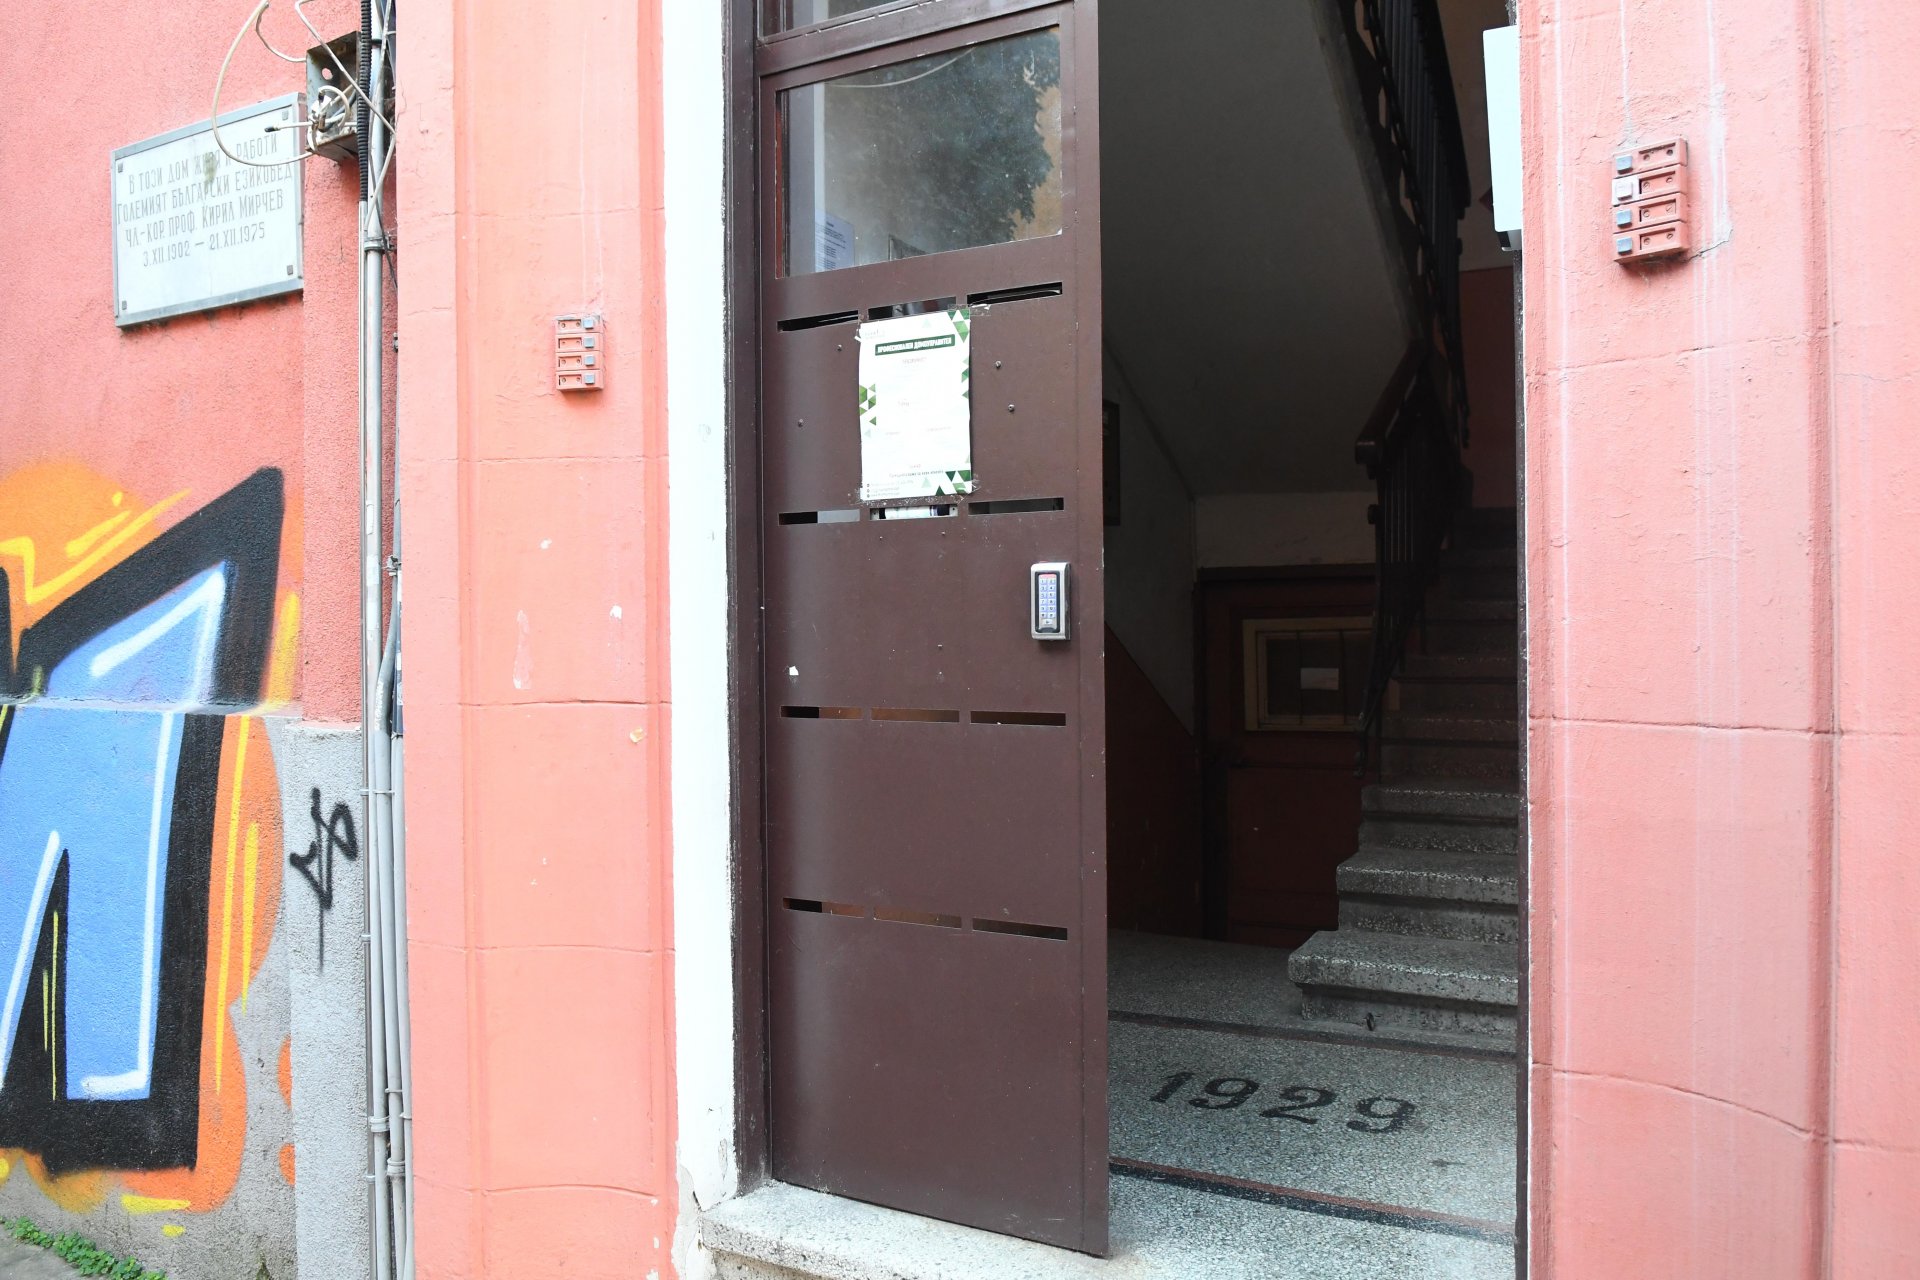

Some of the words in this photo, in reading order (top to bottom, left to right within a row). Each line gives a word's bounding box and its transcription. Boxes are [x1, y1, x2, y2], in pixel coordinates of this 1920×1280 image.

[128, 174, 135, 195] В
[139, 167, 163, 192] ТОЗИ
[167, 158, 189, 184] ДОМ
[236, 133, 278, 161] РАБОТИ
[117, 192, 167, 225] ГОЛЕМИЯТ
[239, 188, 284, 219] МИРЧЕВ
[1149, 1071, 1416, 1134] 1929
